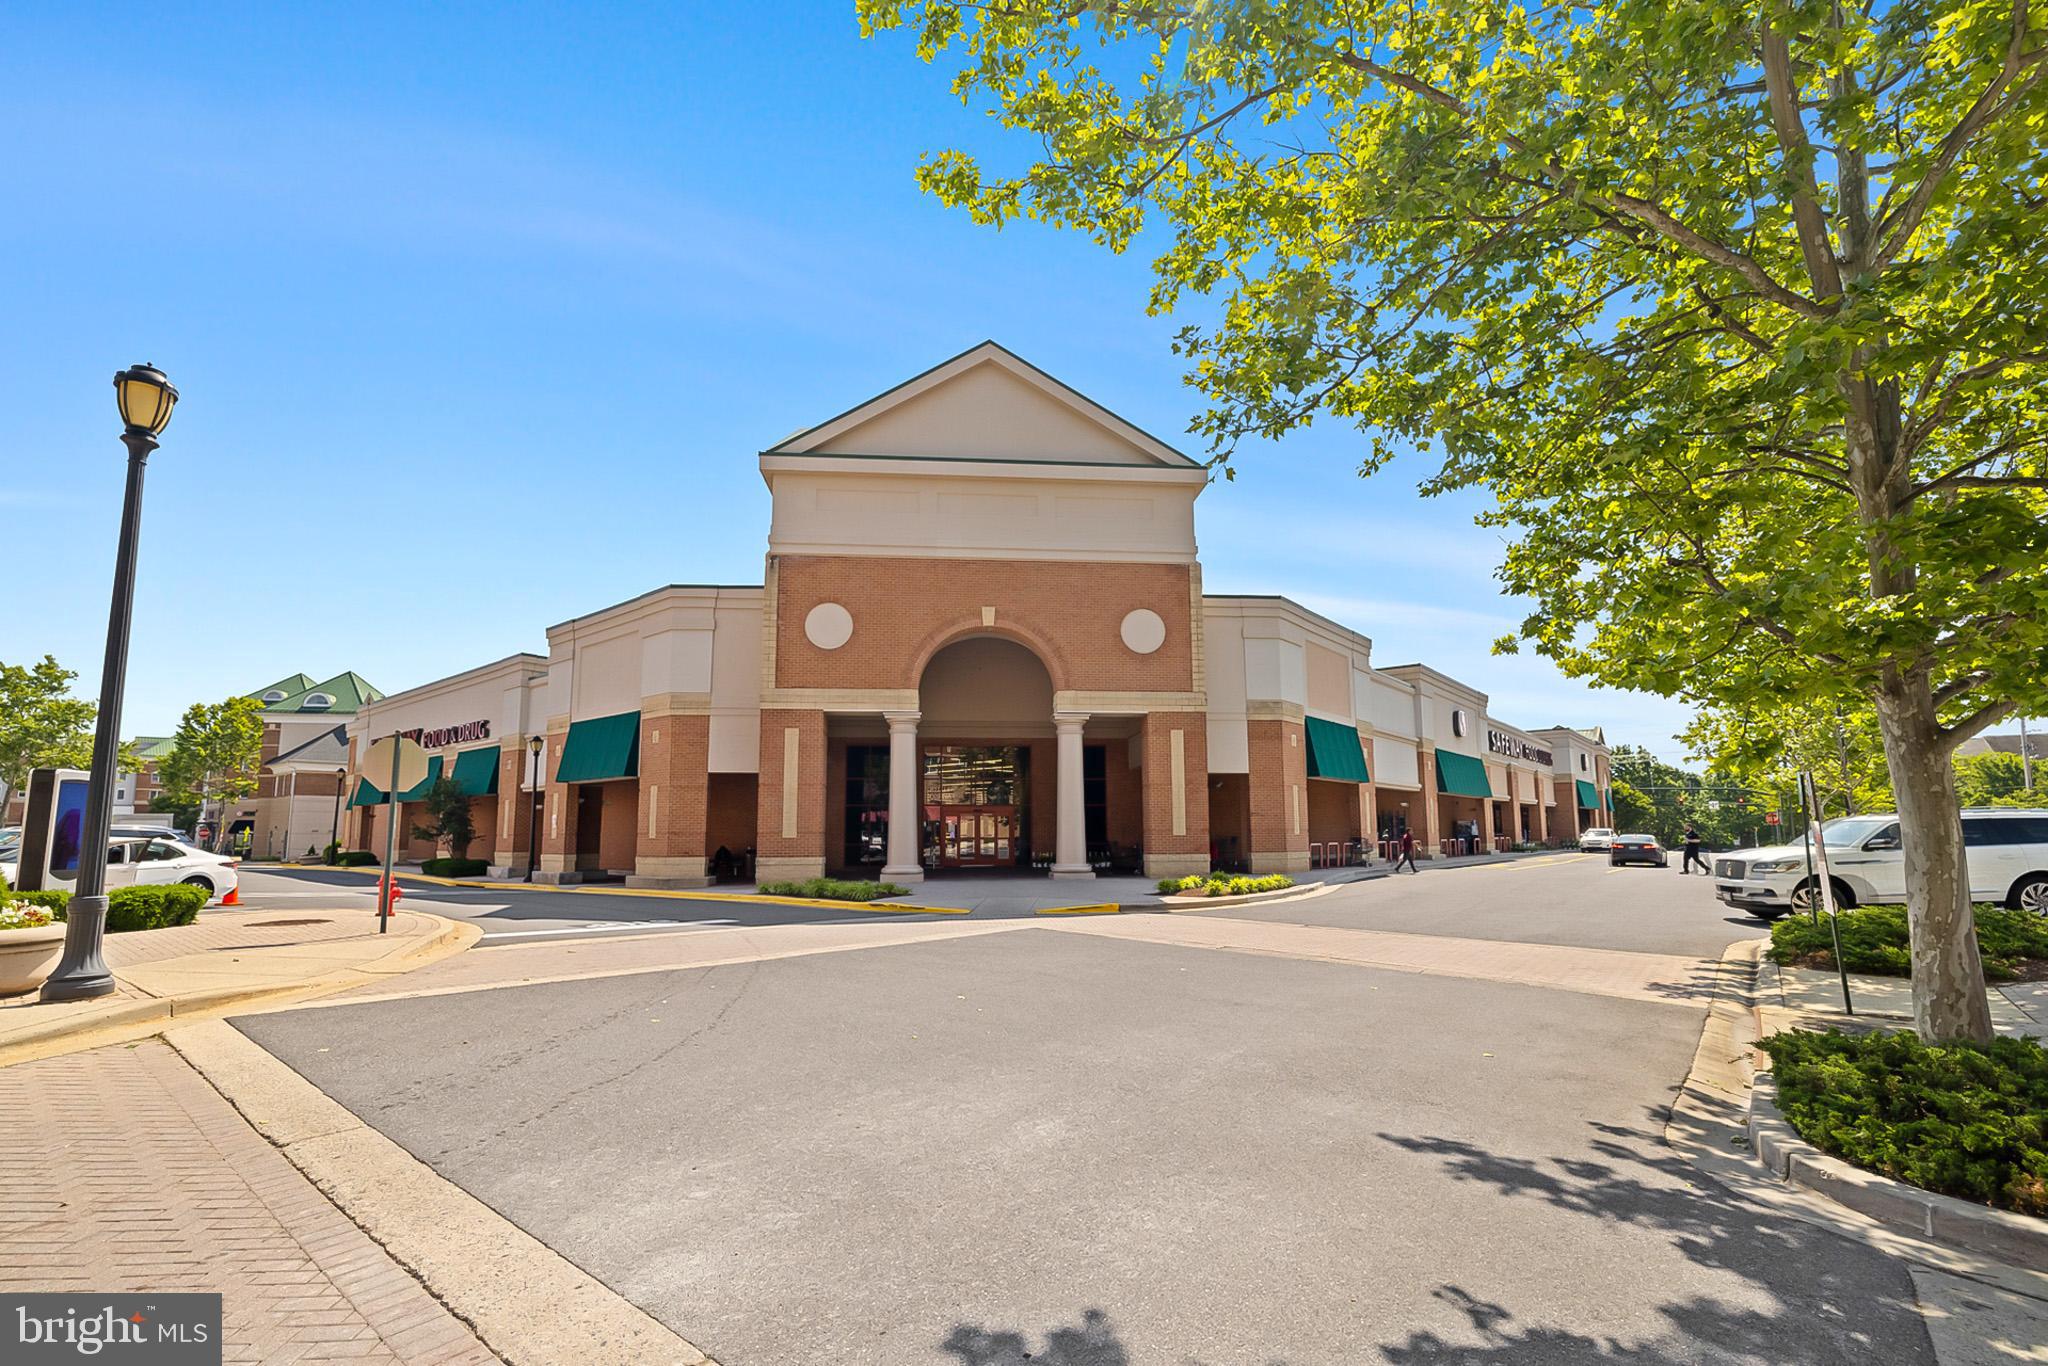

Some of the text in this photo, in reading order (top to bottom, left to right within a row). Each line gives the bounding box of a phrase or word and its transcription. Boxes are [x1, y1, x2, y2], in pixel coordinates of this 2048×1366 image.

[423, 728, 448, 748] FOOD
[458, 721, 487, 742] DRUG
[1490, 730, 1523, 758] SAFEWAY
